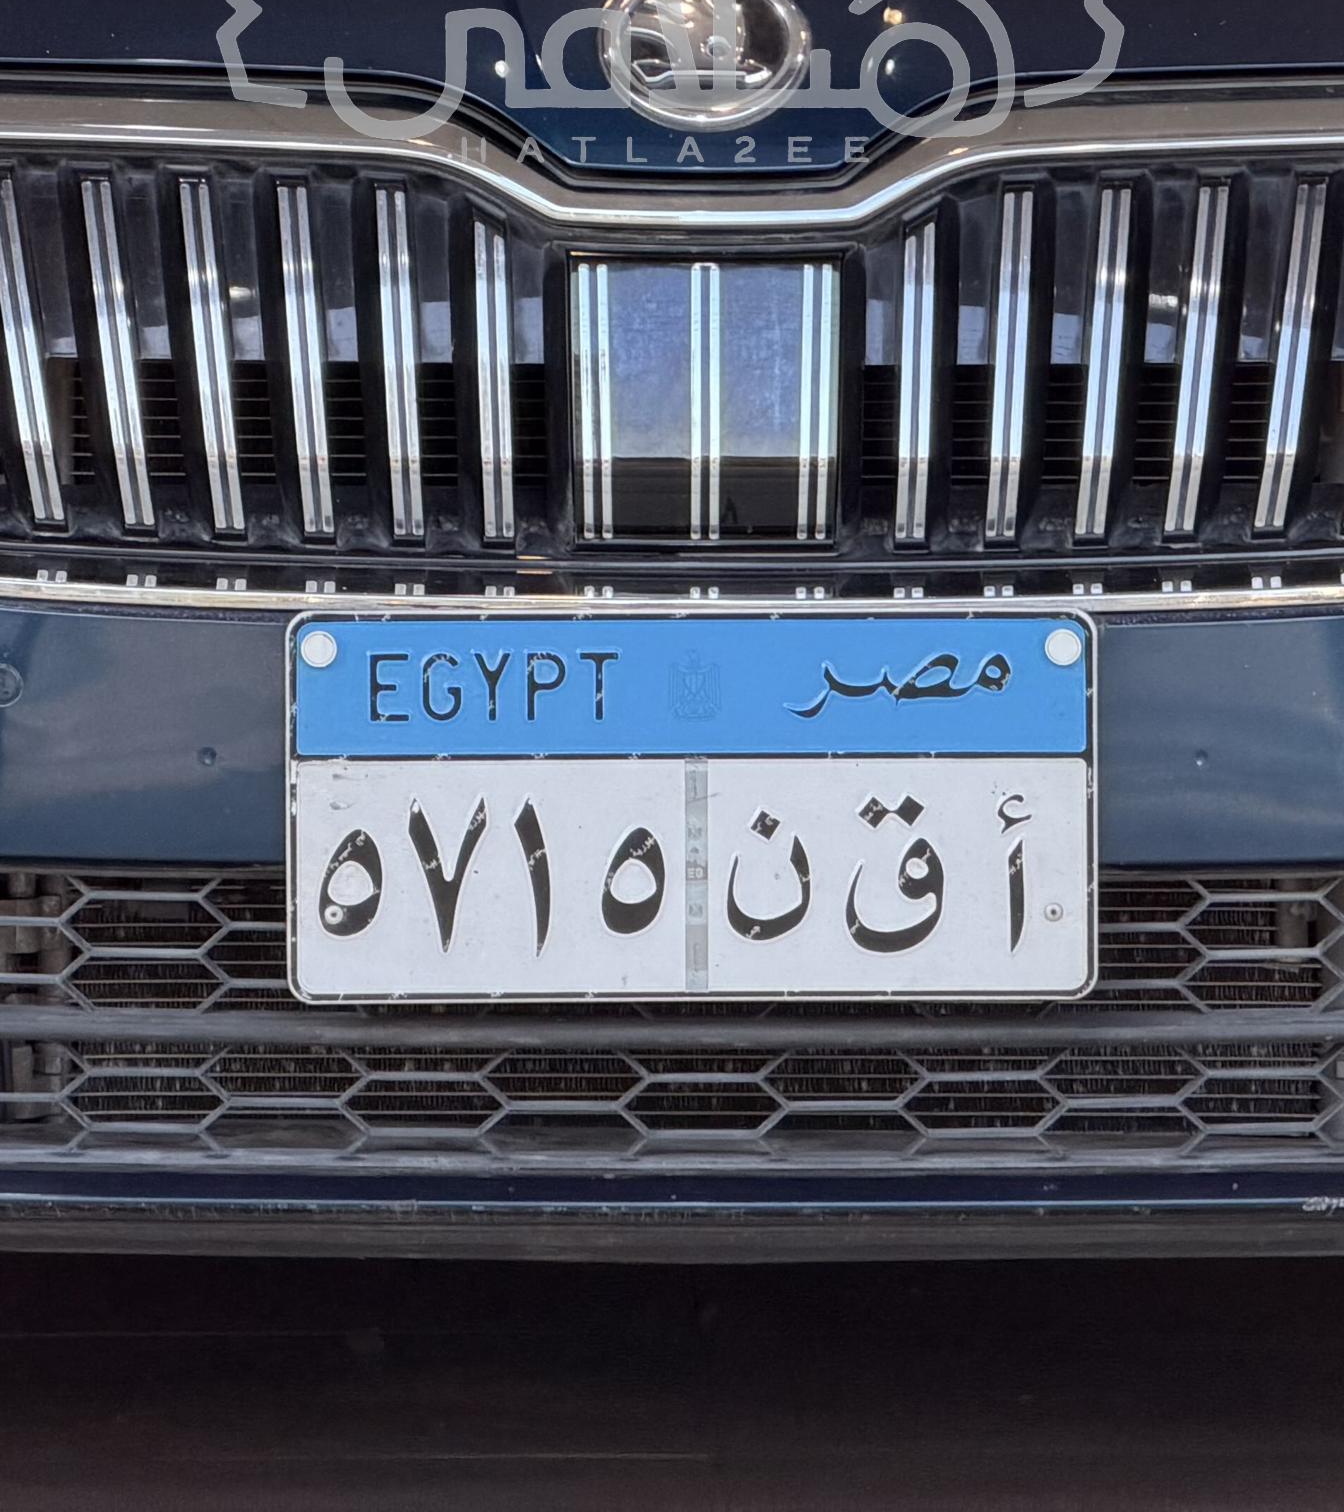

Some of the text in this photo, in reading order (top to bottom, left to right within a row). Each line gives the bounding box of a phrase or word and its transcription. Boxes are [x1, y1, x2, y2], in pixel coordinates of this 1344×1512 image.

[368, 651, 619, 722] EGYPT
[784, 652, 1013, 719] مصر
[318, 796, 665, 957] ٥٧١٥
